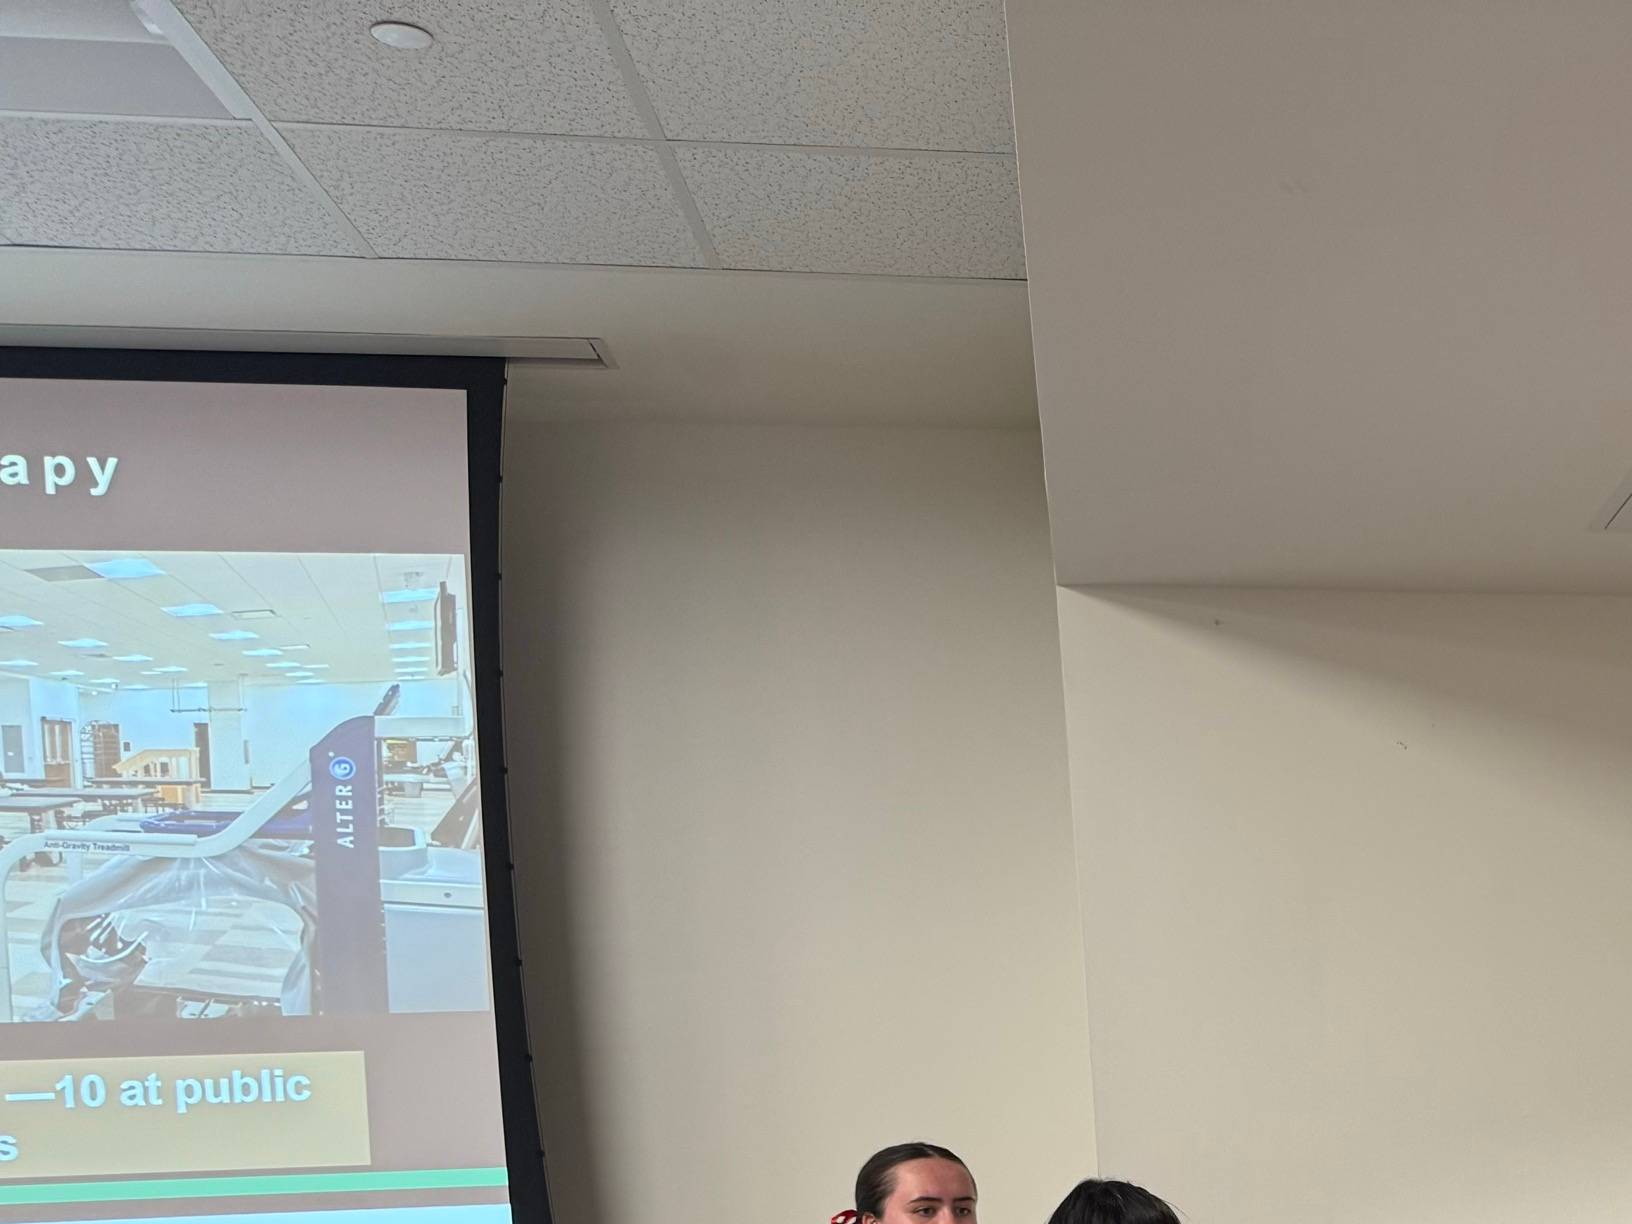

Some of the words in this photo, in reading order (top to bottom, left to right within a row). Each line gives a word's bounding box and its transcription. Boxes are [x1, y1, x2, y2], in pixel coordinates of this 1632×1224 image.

[0, 454, 119, 496] apy
[119, 1073, 164, 1107] at
[175, 1068, 312, 1114] public
